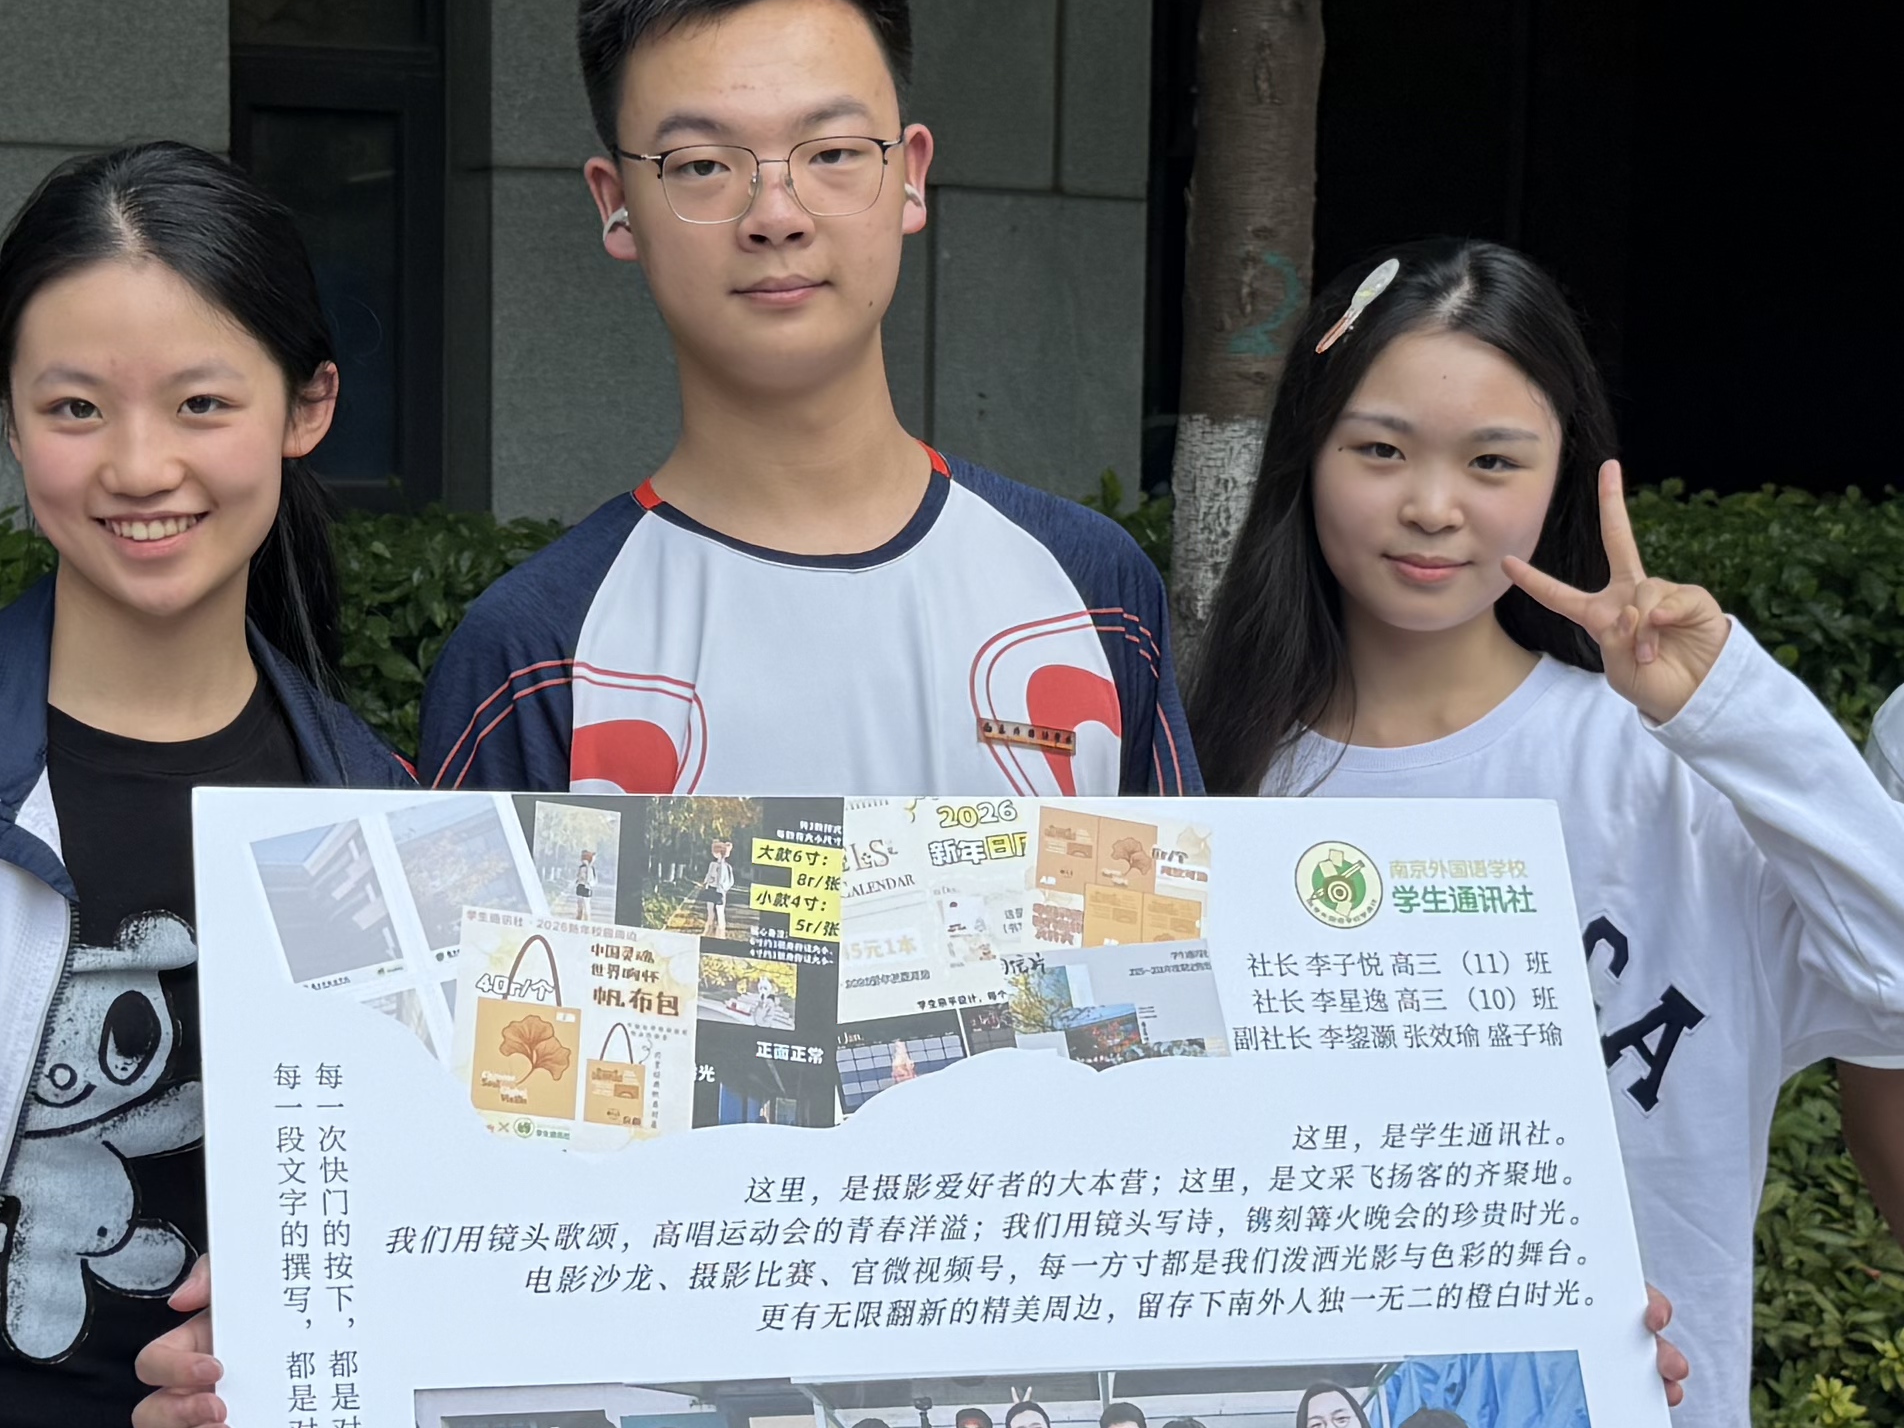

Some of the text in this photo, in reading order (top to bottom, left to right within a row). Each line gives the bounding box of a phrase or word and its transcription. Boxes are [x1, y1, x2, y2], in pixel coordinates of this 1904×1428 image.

[936, 799, 1018, 829] 2026
[796, 872, 841, 892] 8r/张
[1389, 858, 1528, 880] 南京外国语学校
[1391, 883, 1538, 914] 学生通讯社
[794, 918, 840, 938] 5r/张
[1246, 952, 1298, 978] 社长
[1305, 951, 1383, 978] 李子悦
[1391, 952, 1441, 977] 高三
[592, 985, 680, 1017] 帆布包
[1251, 988, 1304, 1014] 社长
[1311, 987, 1389, 1014] 李星逸
[1397, 987, 1448, 1013] 高三
[755, 1040, 825, 1065] 正面正常
[1232, 1025, 1311, 1052] 副社长
[1292, 1119, 1569, 1153] 这里，是学生通讯社。
[744, 1162, 1577, 1206] 这里，是摄影爱好者的大本营；这里，是文采飞扬客的齐聚地。
[385, 1201, 1583, 1257] 我们用镜头歌颂，高唱运动会的青春洋溢；我们用镜头写诗，镌刻篝火晚会的珍贵时光。
[525, 1239, 1590, 1294] 电影沙龙、摄影比赛、官微视频号，每一方寸都是我们泼洒光影与色彩的舞台。
[755, 1280, 1596, 1332] 更有无限翻新的精美周边，留存下南外人独一无二的橙白时光。
